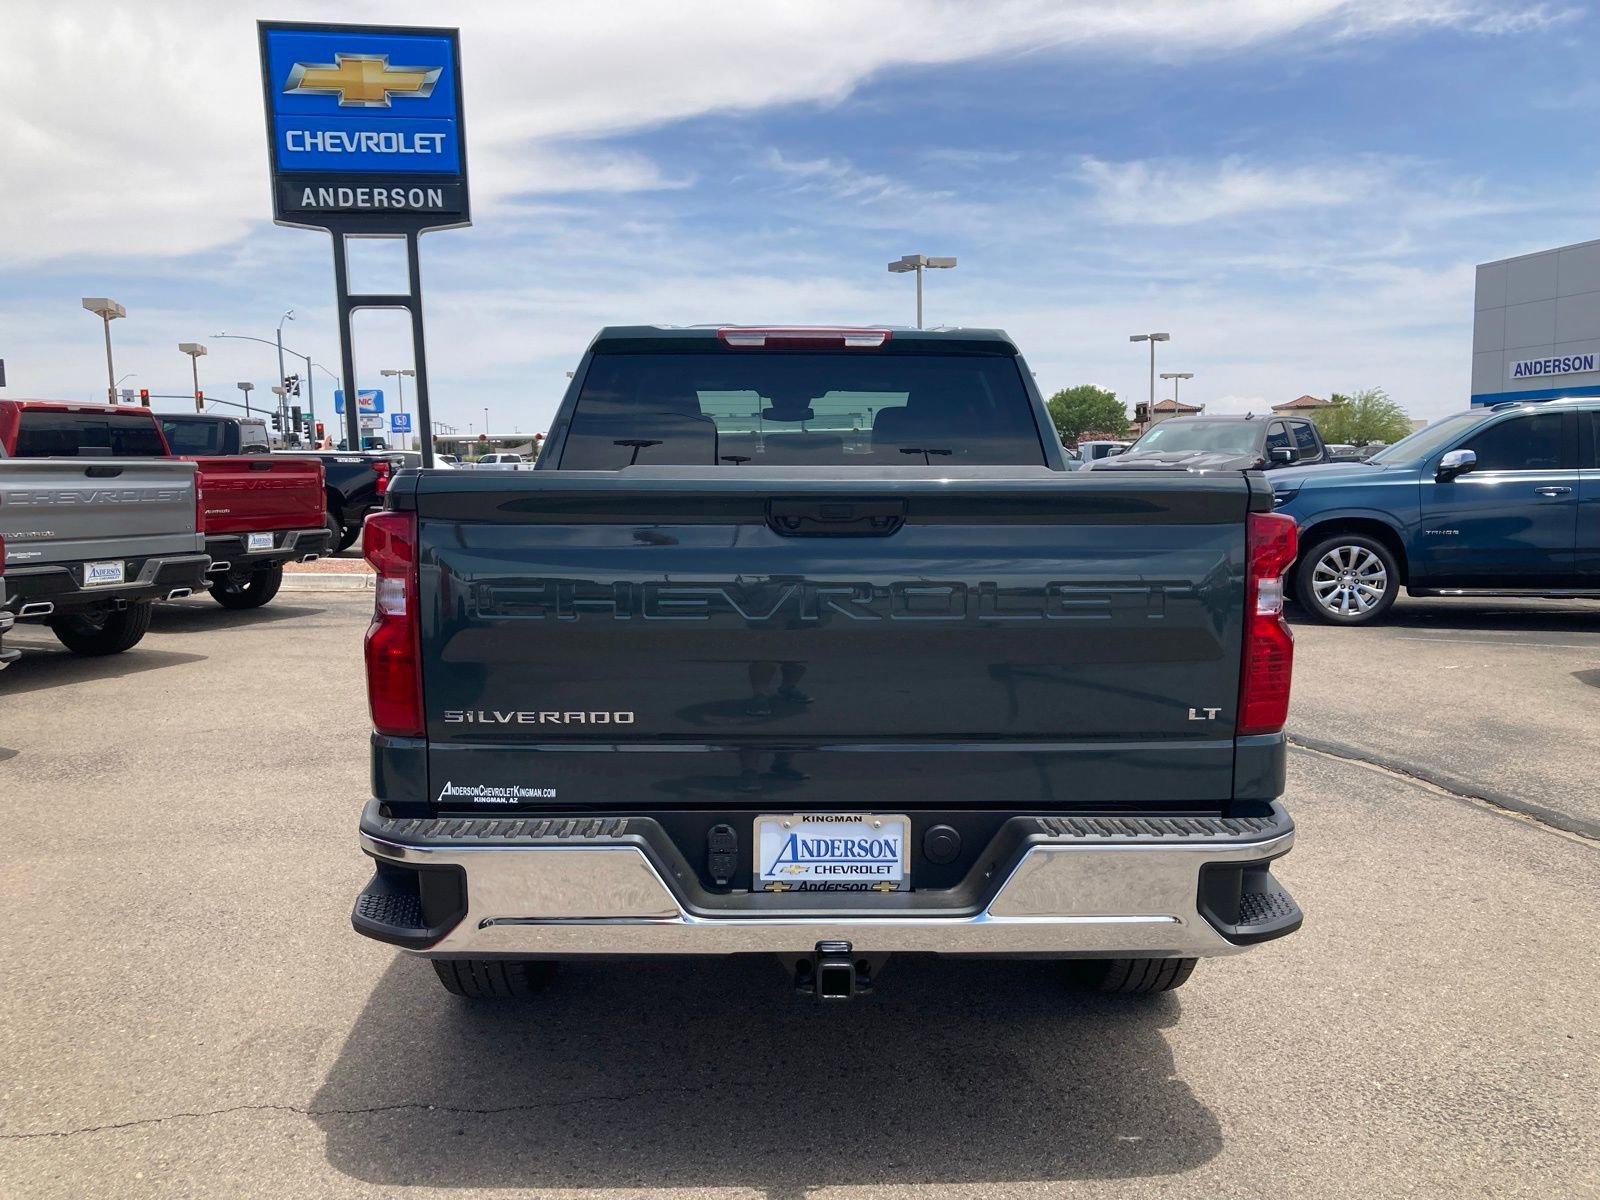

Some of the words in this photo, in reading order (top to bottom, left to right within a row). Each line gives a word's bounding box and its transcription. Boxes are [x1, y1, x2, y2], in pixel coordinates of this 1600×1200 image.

[285, 130, 446, 154] CHEVROLET
[301, 187, 443, 208] ANDERSON
[1514, 355, 1594, 377] ANDERSON
[7, 490, 187, 505] CHEVROLET
[87, 567, 121, 582] ANDERSON
[475, 580, 1194, 621] CHEVROLET
[443, 710, 635, 725] SILVERADO
[1188, 707, 1222, 721] LT
[764, 833, 898, 876] ANDERSON
[814, 865, 893, 874] CHEVROLET
[798, 881, 868, 892] Anderson
